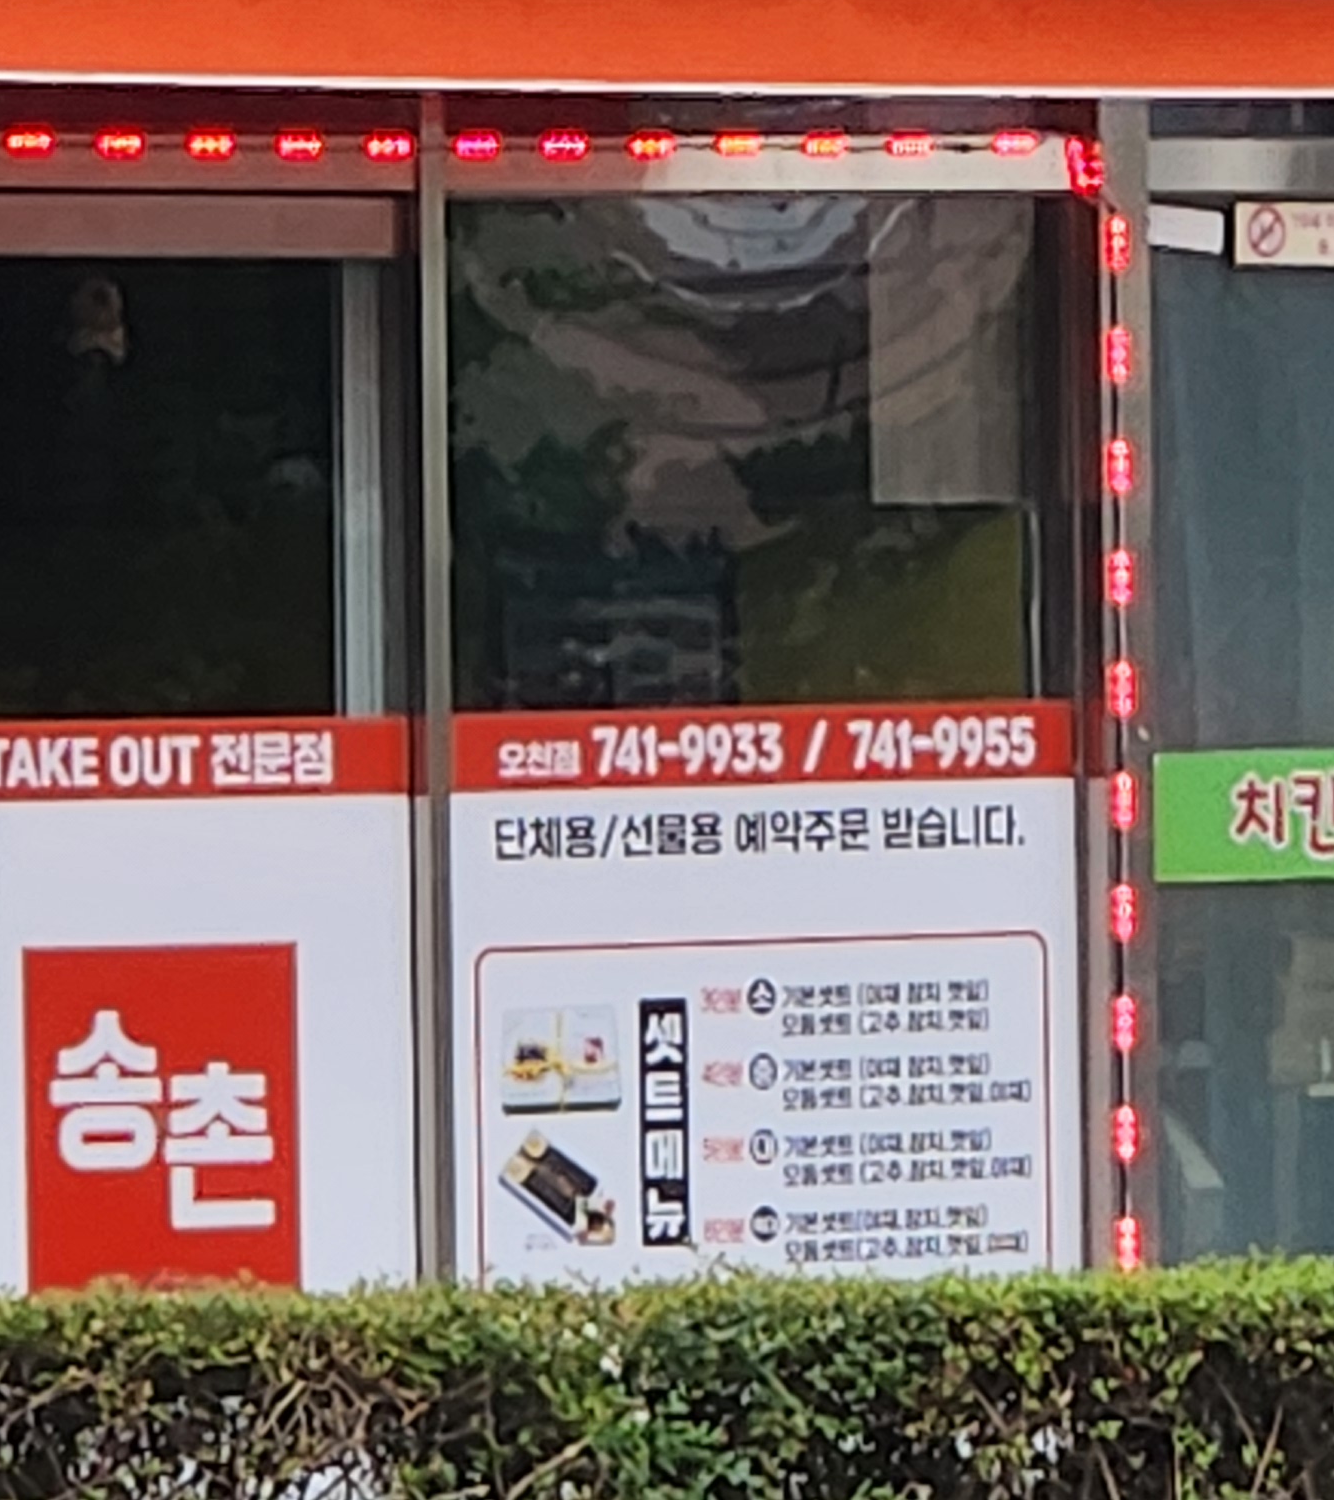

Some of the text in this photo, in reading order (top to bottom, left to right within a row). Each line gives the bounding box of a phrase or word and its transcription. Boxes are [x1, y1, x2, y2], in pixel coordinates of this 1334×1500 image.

[108, 735, 201, 786] OUT
[210, 731, 334, 787] 전문점
[591, 722, 784, 777] 741-9933
[803, 719, 828, 774] /
[847, 716, 1037, 770] 741-9955
[494, 803, 1027, 861] 단체용/선물용 예약주문 받습니다.
[48, 1009, 277, 1231] 송촌
[644, 1012, 686, 1241] 셋트메뉴
